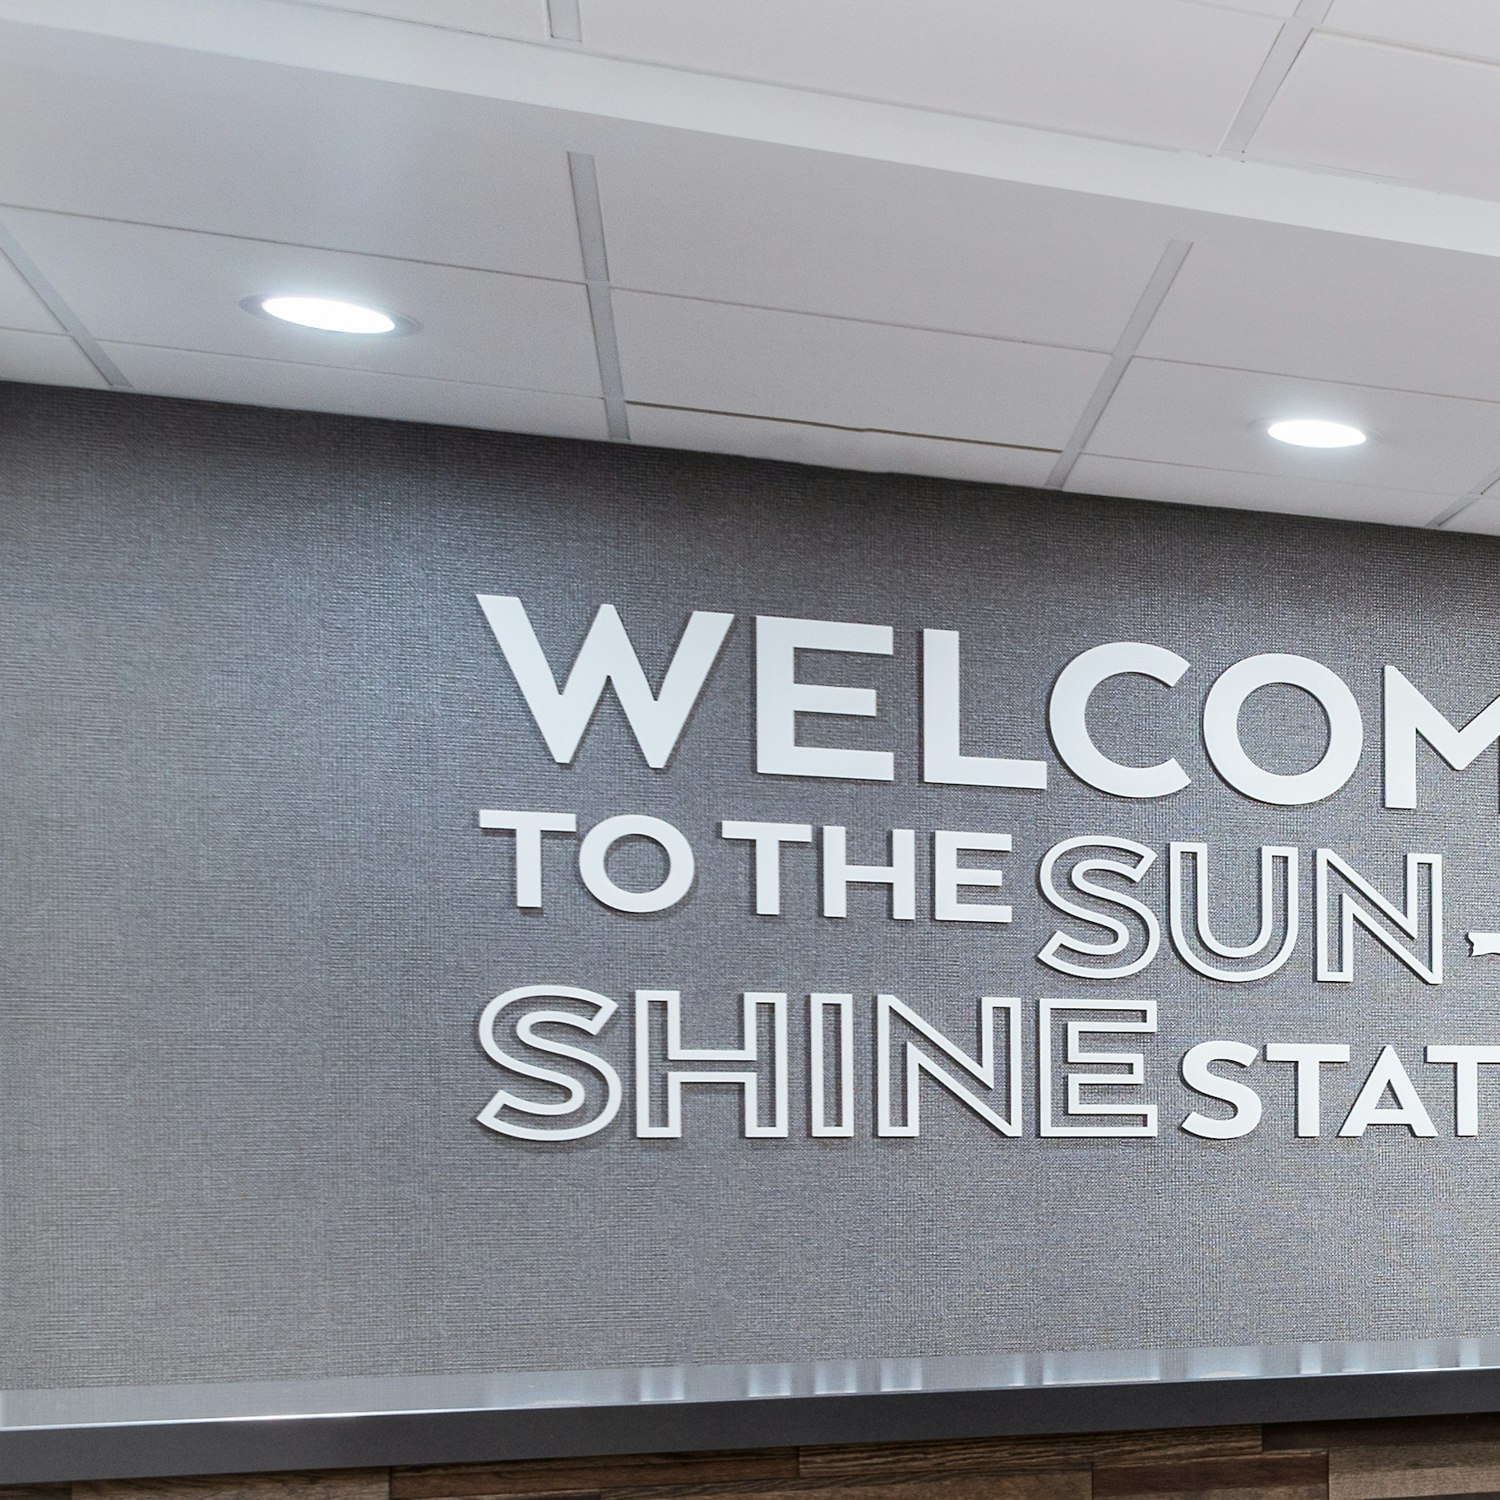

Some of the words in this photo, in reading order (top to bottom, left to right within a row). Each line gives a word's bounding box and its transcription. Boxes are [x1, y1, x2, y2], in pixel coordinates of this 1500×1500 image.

[480, 809, 695, 915] TO
[720, 820, 1014, 924] THE
[1036, 835, 1444, 986] SUN
[476, 983, 1159, 1140] SHINE
